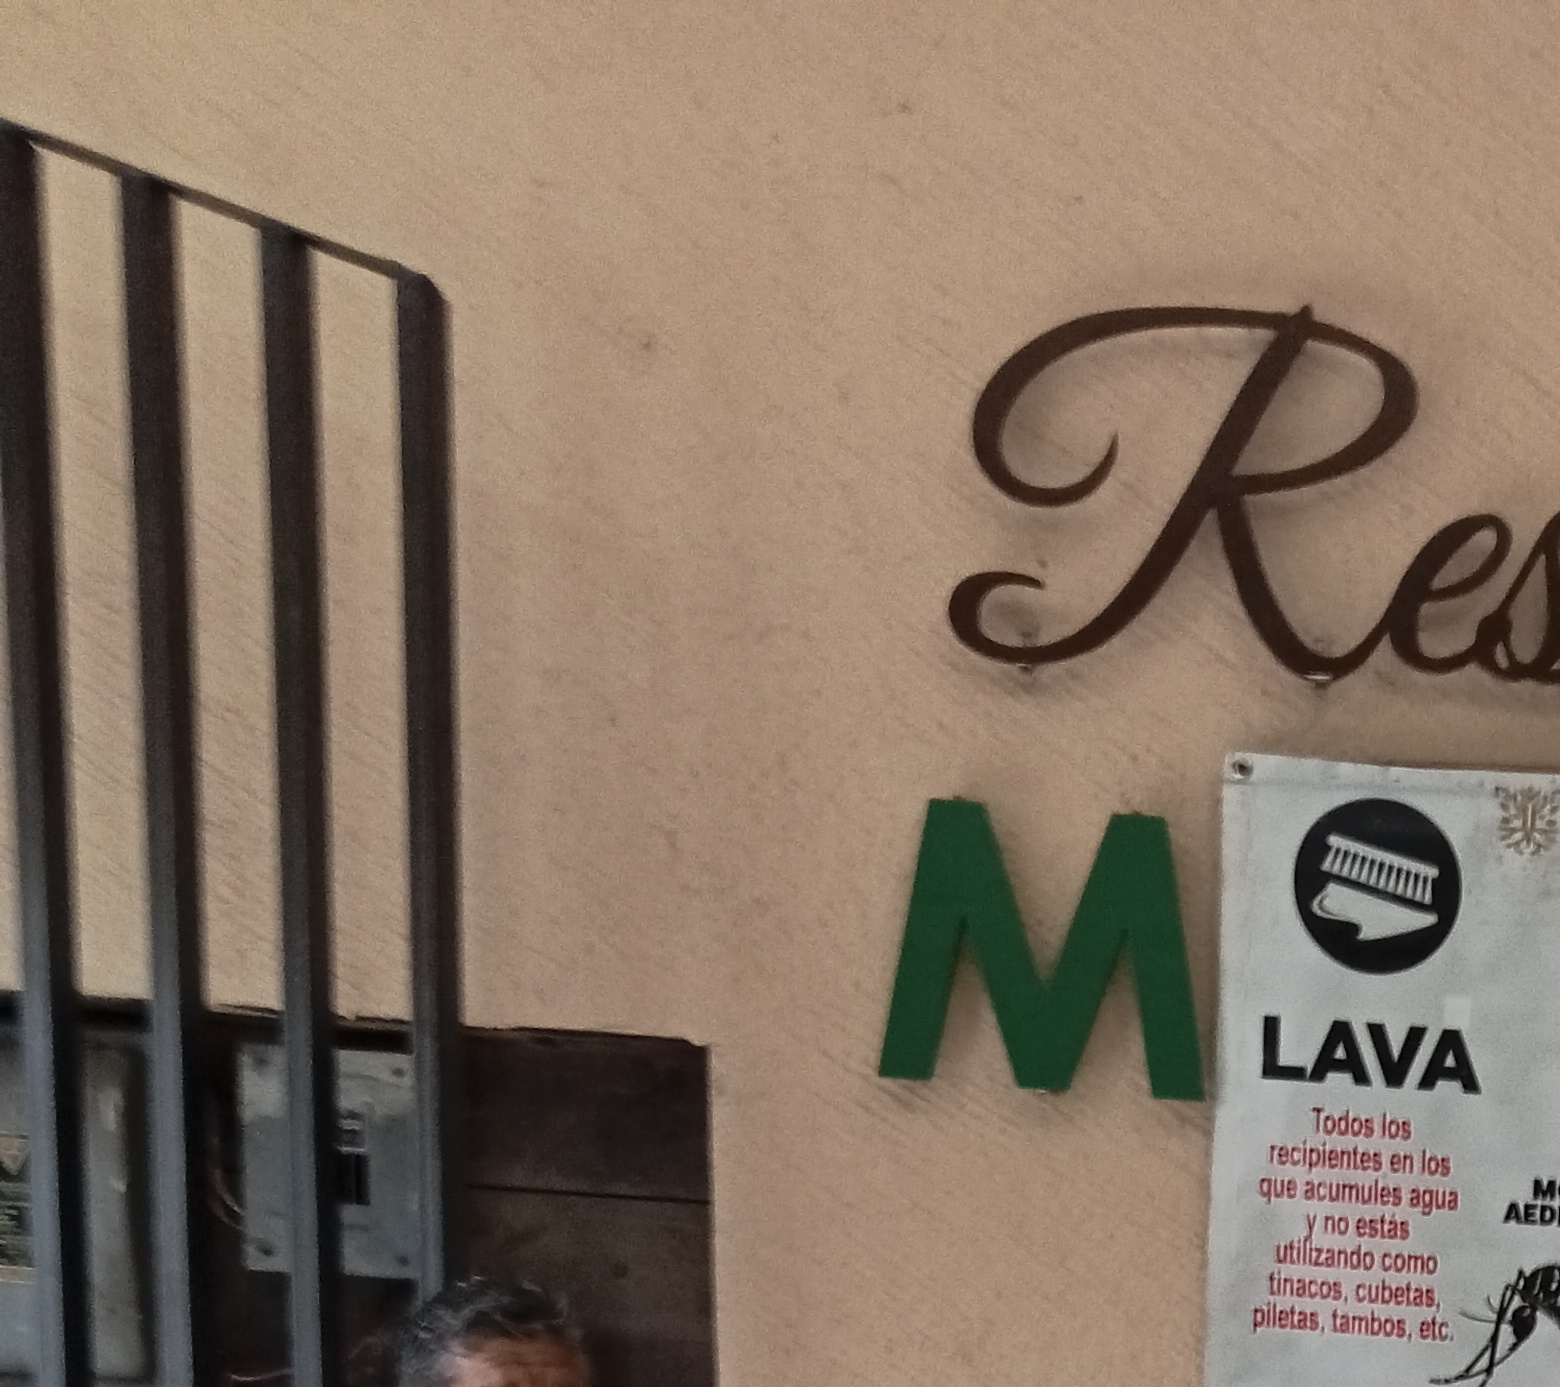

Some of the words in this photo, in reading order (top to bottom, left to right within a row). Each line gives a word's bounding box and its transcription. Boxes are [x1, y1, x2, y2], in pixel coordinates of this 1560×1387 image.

[1261, 1015, 1482, 1095] LAVA
[1312, 1107, 1375, 1138] Todos
[1382, 1112, 1412, 1140] los
[1269, 1140, 1383, 1173] recipientes
[1389, 1152, 1414, 1174] en
[1421, 1148, 1451, 1177] los
[1259, 1177, 1298, 1205] que
[1303, 1180, 1403, 1207] acumules
[1408, 1188, 1459, 1217] agua
[1306, 1213, 1317, 1238] y
[1324, 1214, 1349, 1236] no
[1276, 1238, 1376, 1271] utilizando
[1381, 1252, 1438, 1275] como
[1269, 1269, 1348, 1304] tinacos,
[1355, 1279, 1441, 1312] cubetas,
[1252, 1302, 1326, 1334] piletas,
[1332, 1309, 1413, 1342] tambos,
[1419, 1316, 1454, 1342] etc.
